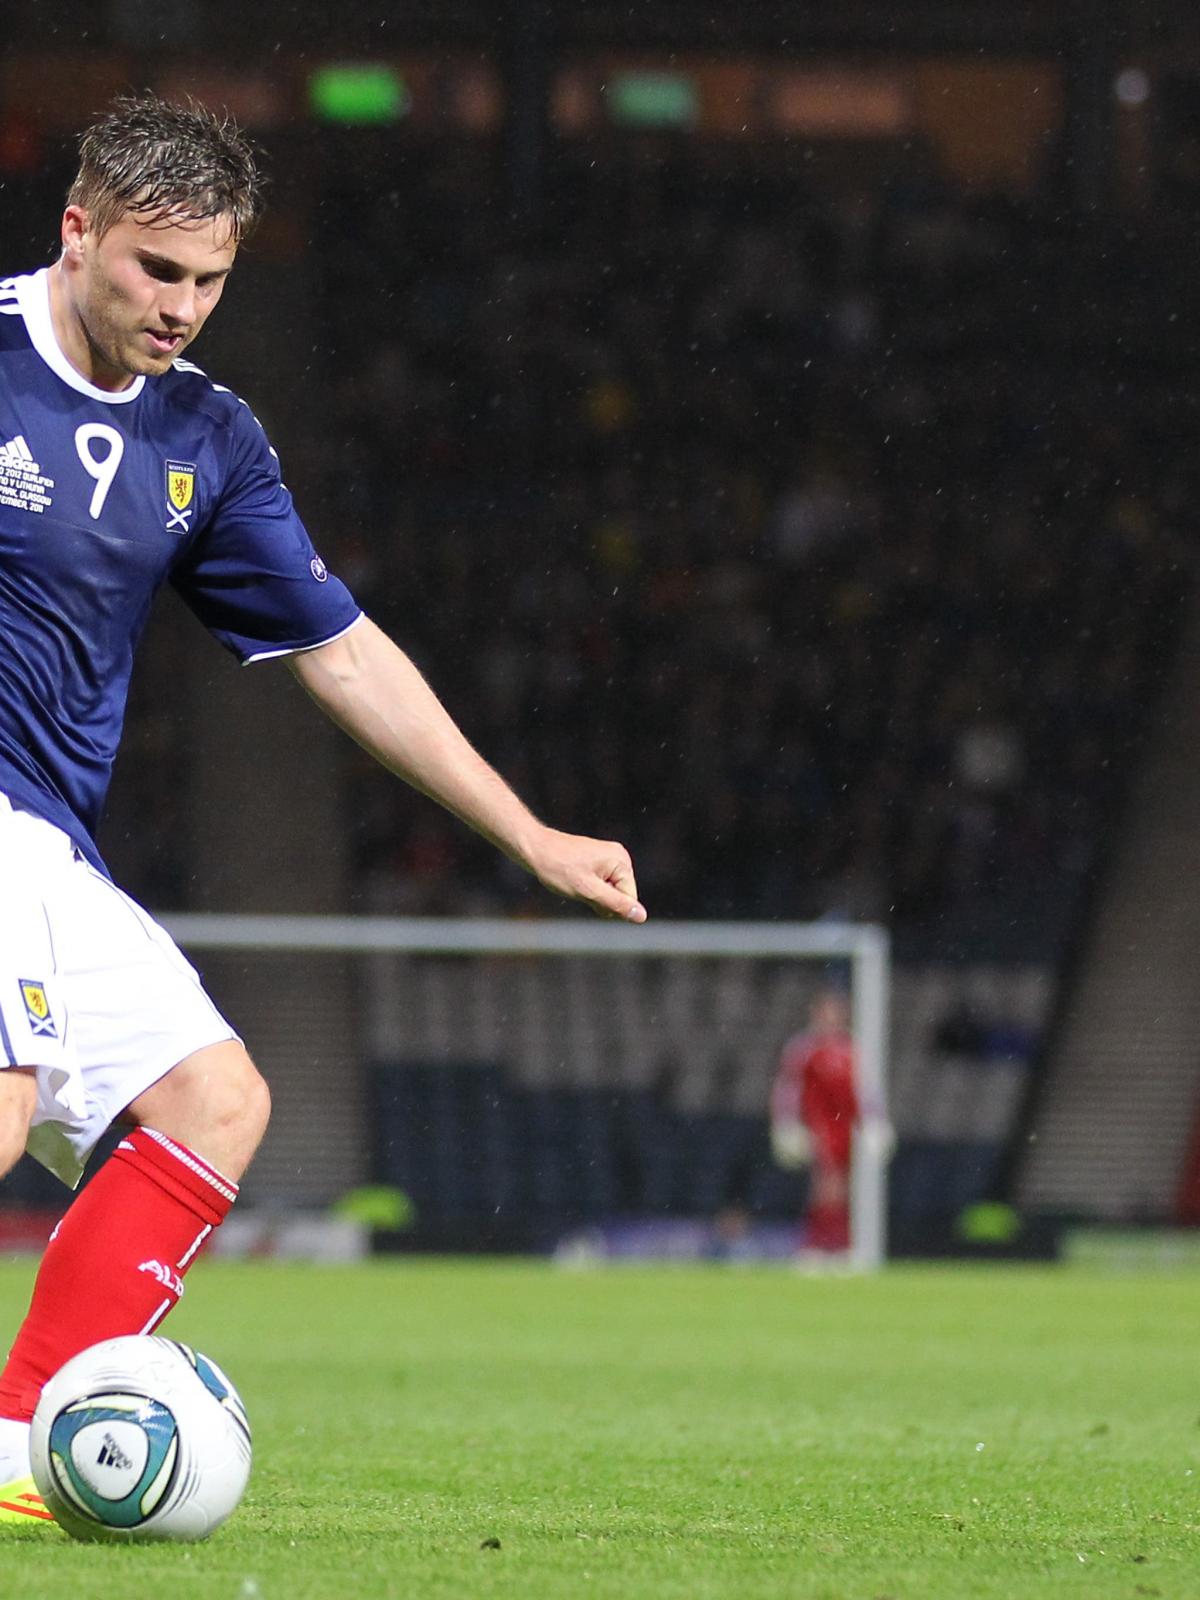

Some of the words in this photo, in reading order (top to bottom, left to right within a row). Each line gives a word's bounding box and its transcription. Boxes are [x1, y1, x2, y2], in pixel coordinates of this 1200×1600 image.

[5, 468, 22, 480] 2012
[75, 422, 124, 519] 9
[19, 490, 52, 506] GLASGOW
